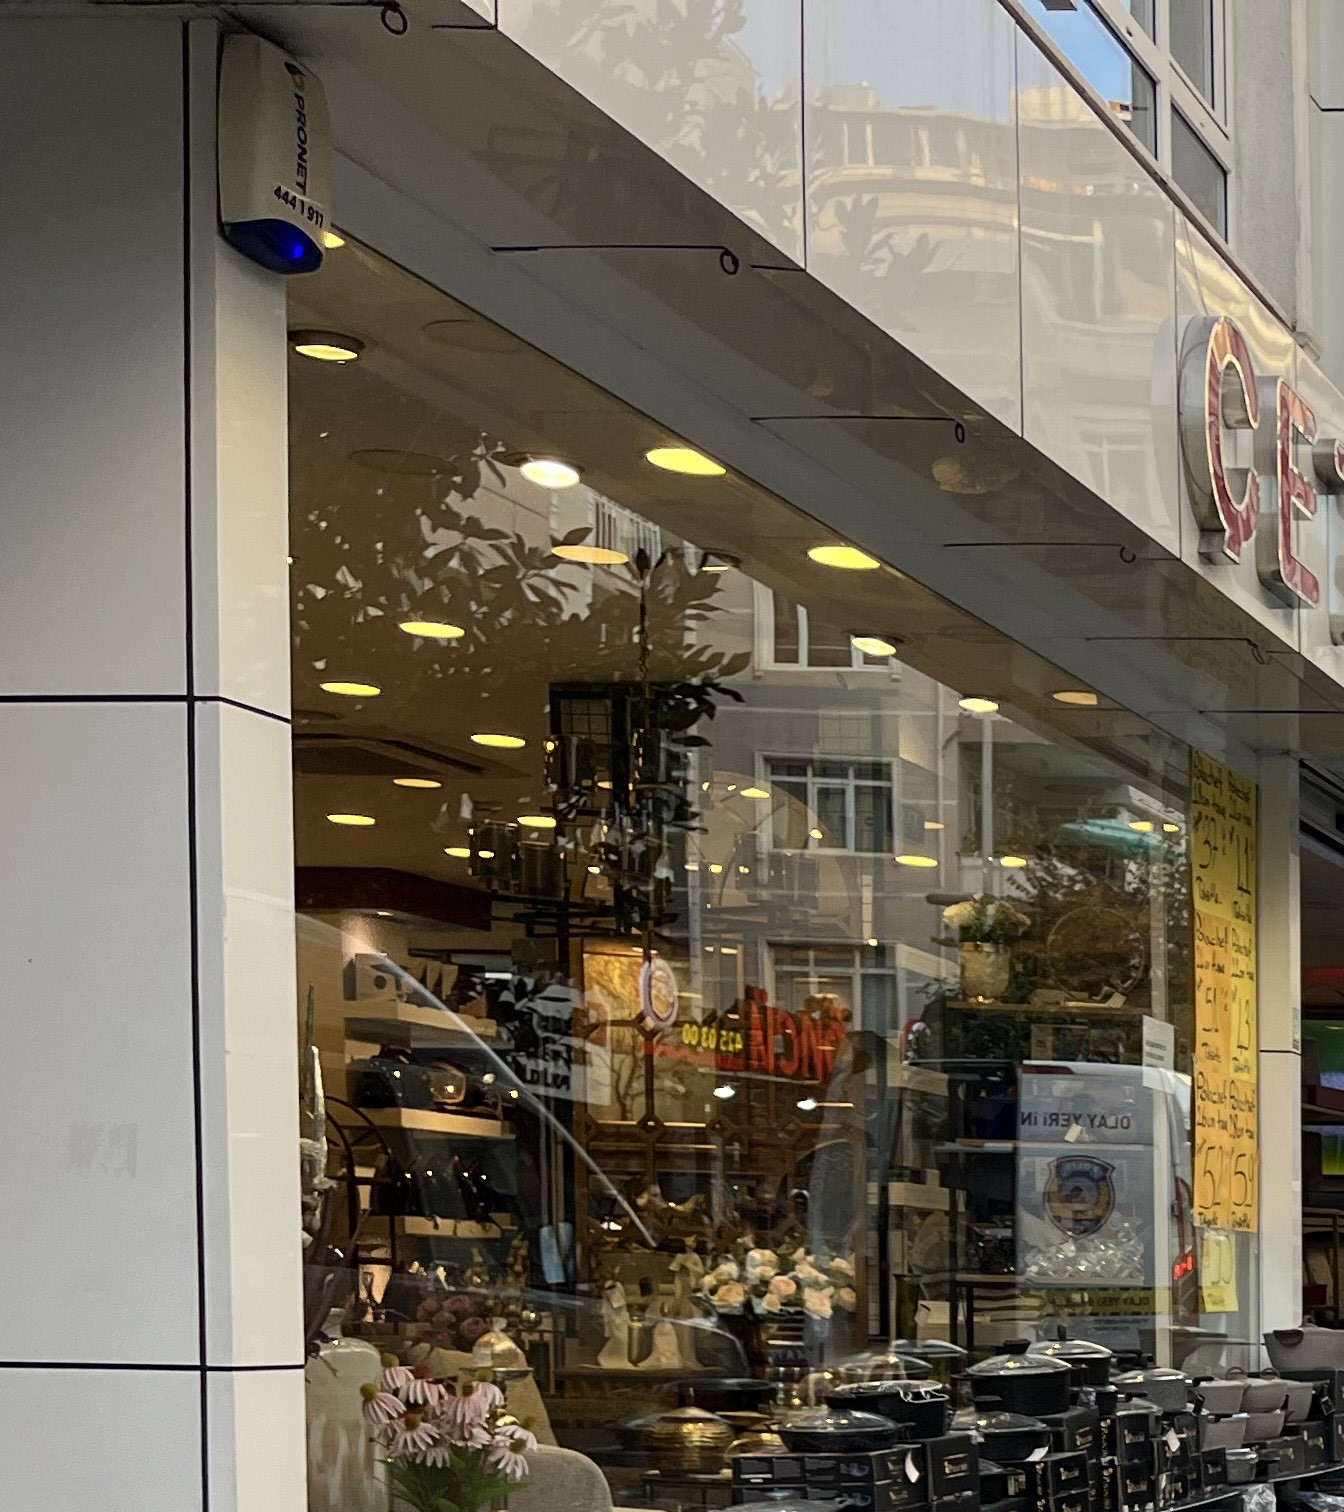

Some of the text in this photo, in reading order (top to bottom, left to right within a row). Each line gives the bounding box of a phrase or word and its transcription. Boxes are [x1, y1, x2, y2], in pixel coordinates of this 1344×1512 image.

[295, 92, 307, 197] PRONET
[274, 185, 297, 211] 444
[307, 205, 324, 229] 911
